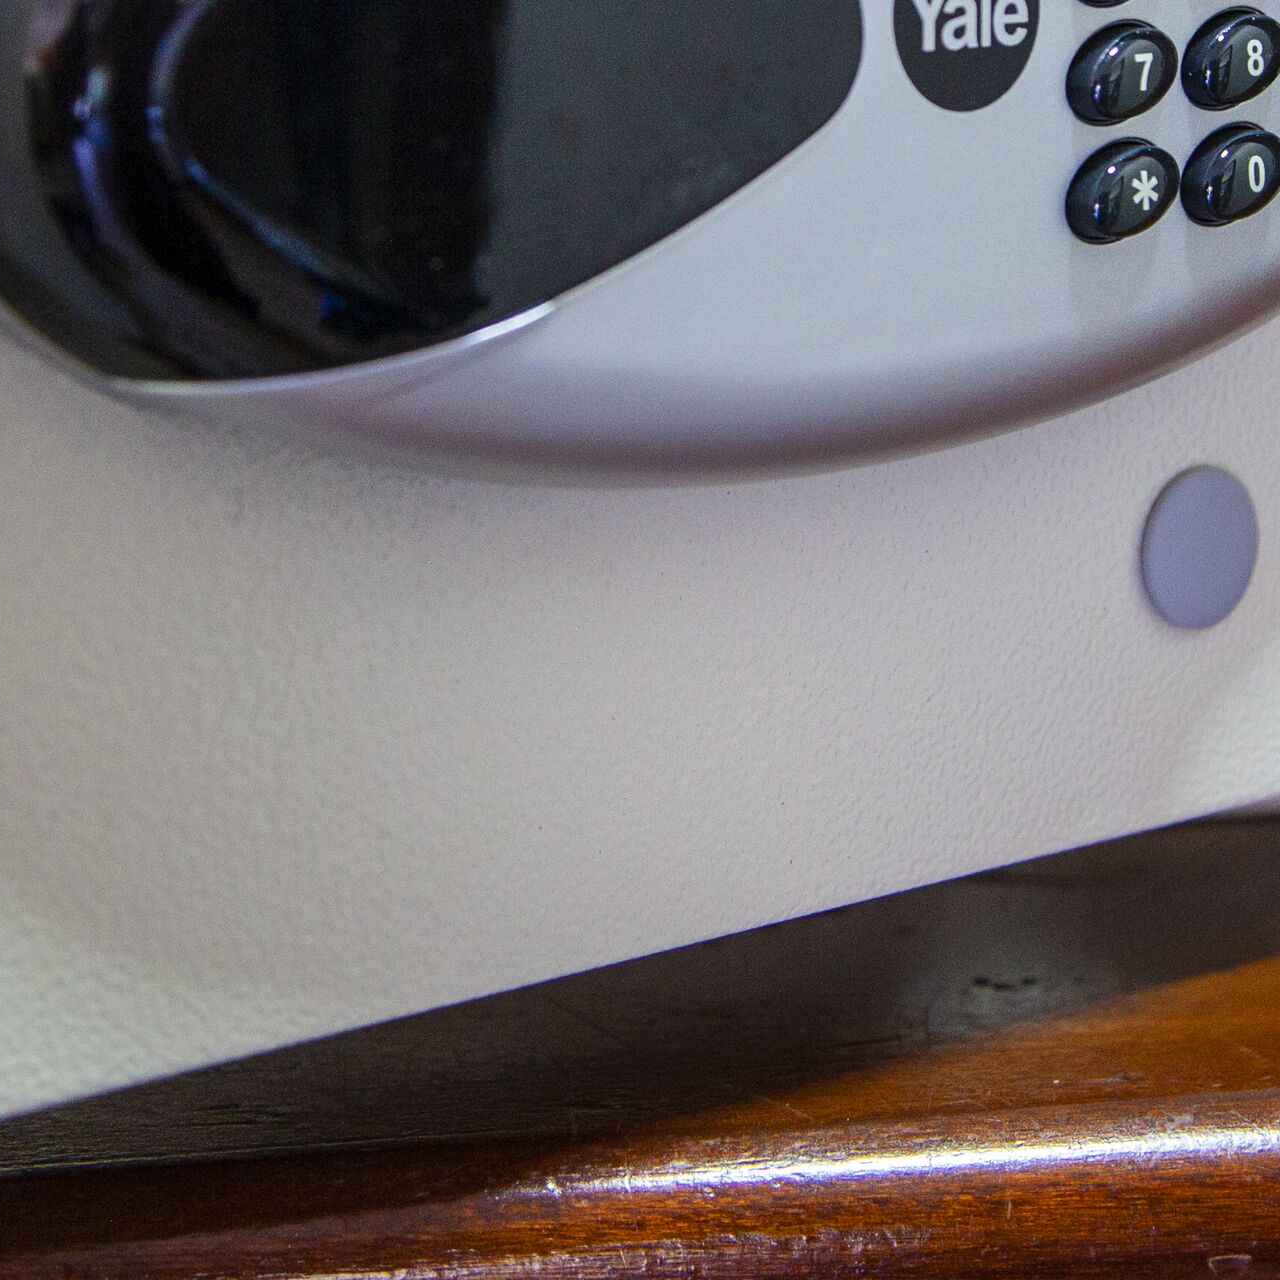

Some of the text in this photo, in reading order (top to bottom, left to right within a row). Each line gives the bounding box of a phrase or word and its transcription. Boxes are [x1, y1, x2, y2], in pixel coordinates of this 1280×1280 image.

[1135, 52, 1154, 92] 7
[1247, 39, 1264, 78] 8
[1248, 155, 1266, 194] 0
